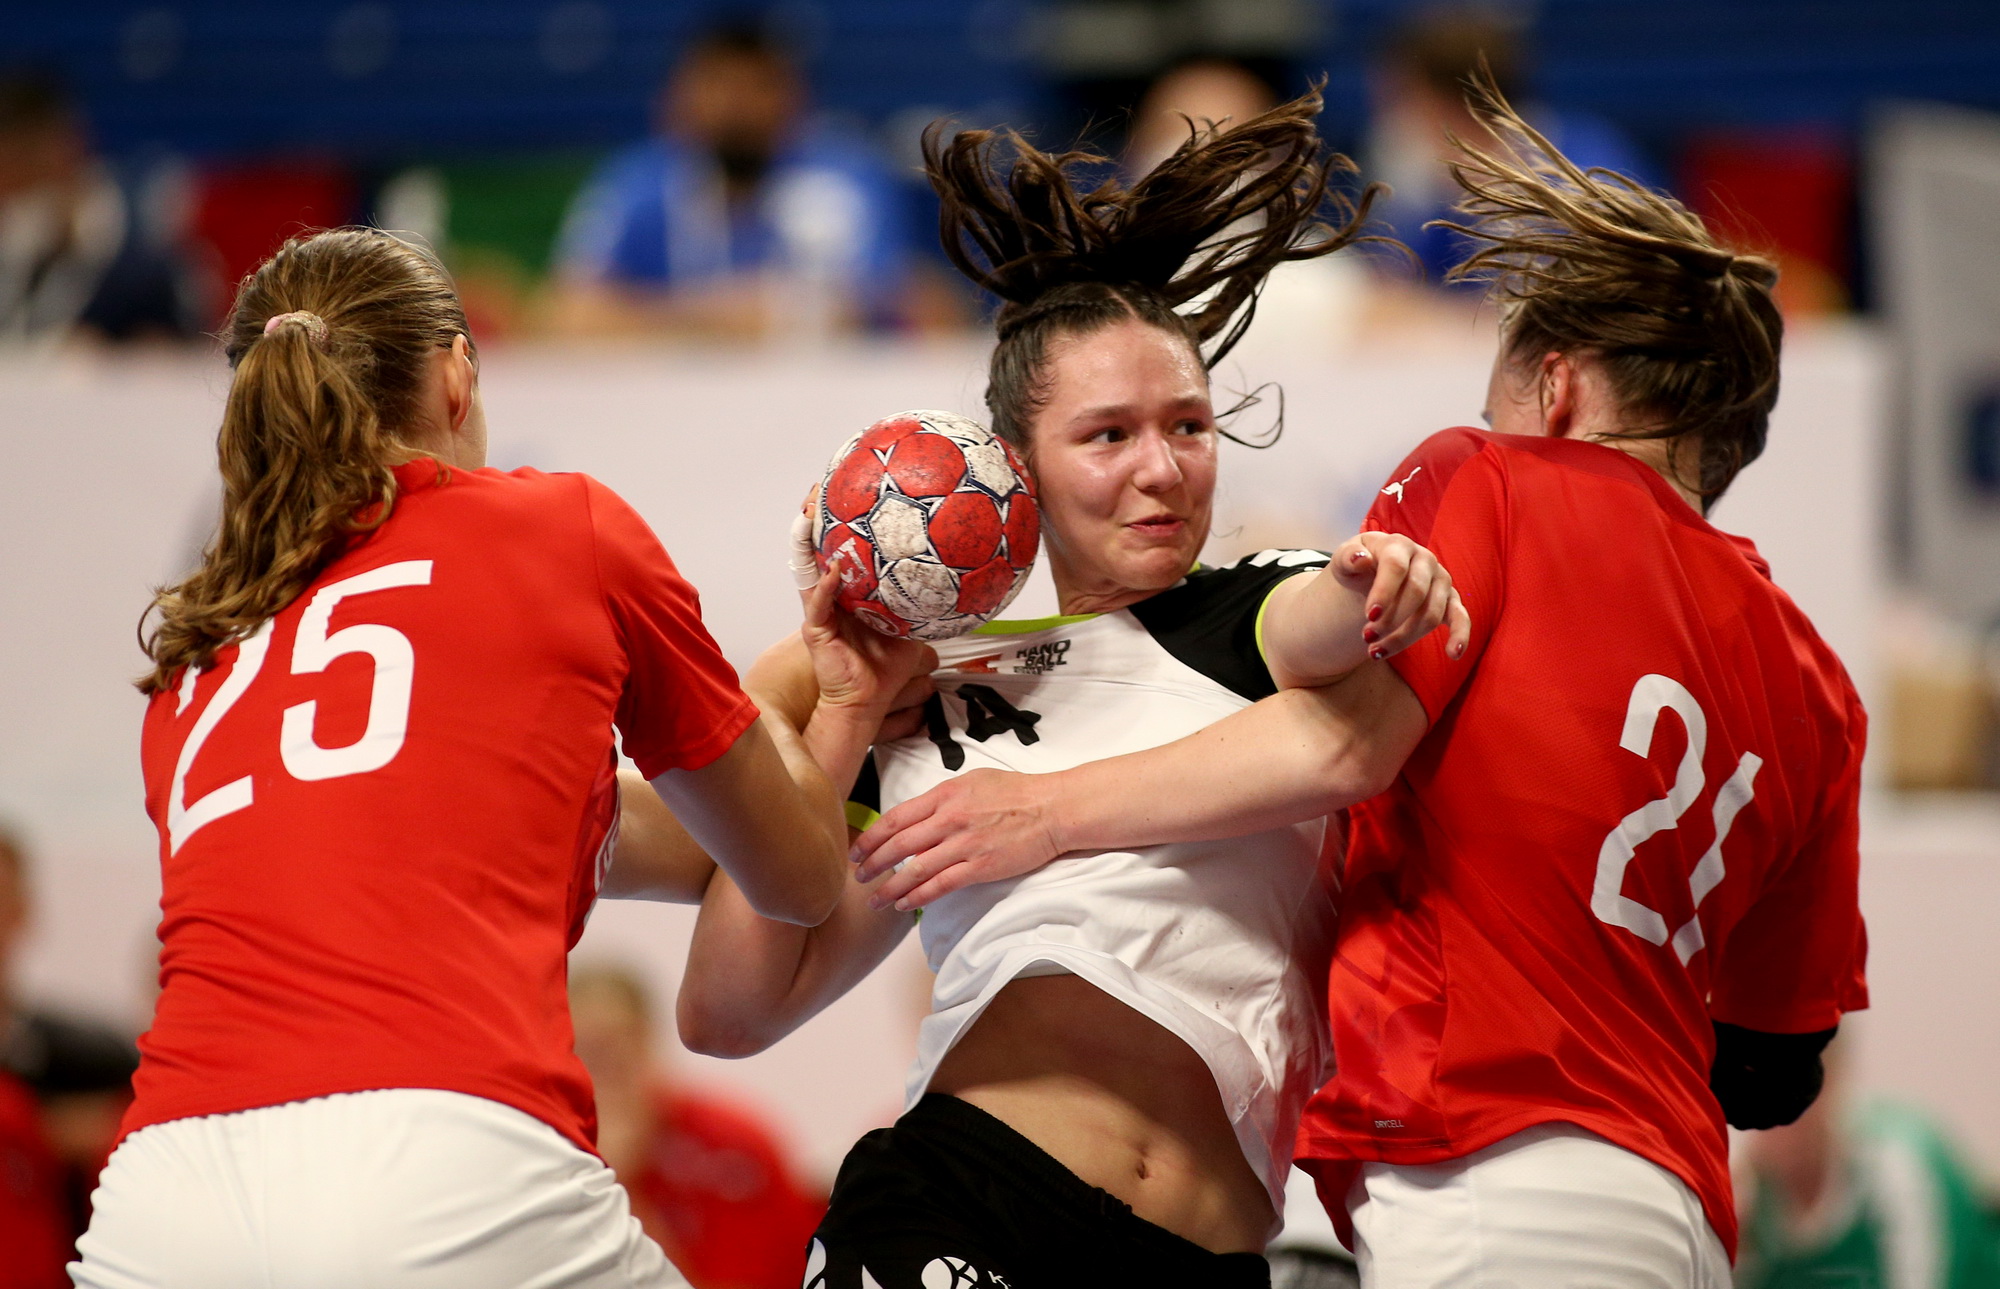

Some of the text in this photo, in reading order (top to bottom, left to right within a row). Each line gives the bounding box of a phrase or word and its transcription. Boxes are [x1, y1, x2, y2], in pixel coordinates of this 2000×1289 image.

[1016, 638, 1071, 659] HAND
[1025, 651, 1067, 668] BALL
[166, 559, 434, 858] 25
[924, 683, 1042, 772] 14
[1590, 673, 1764, 968] 21
[1374, 1119, 1405, 1129] DRYCELL
